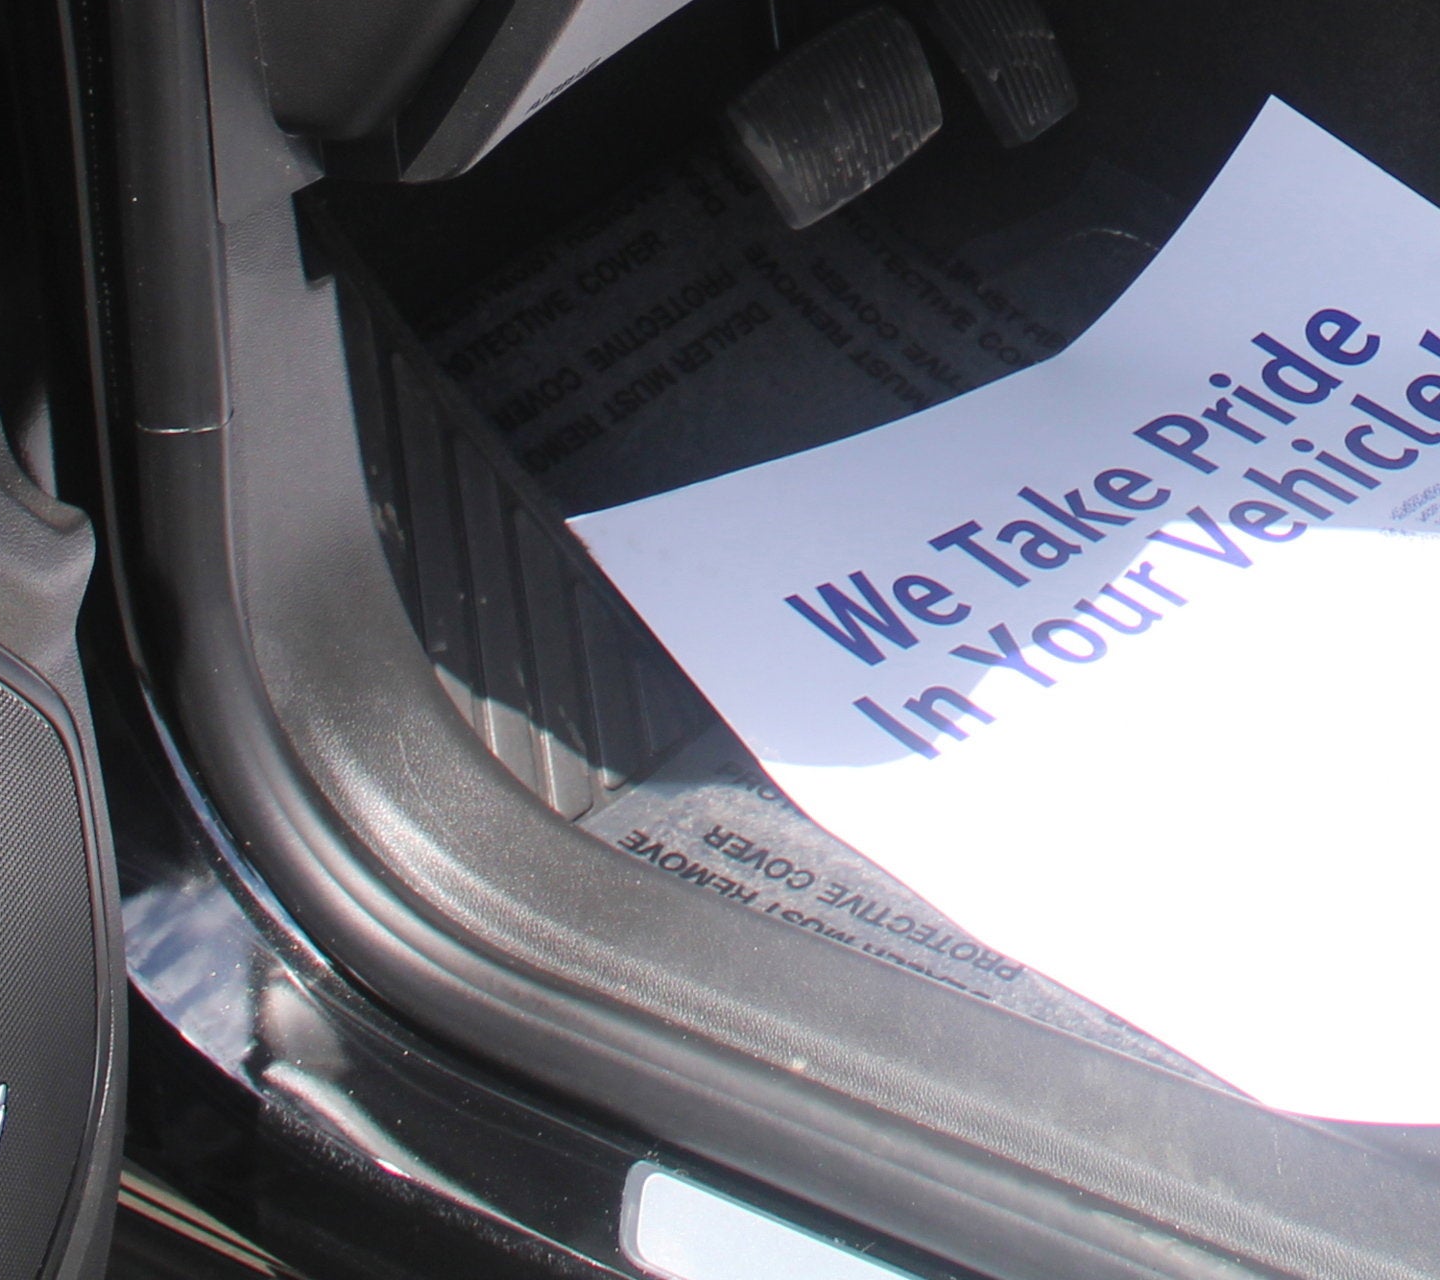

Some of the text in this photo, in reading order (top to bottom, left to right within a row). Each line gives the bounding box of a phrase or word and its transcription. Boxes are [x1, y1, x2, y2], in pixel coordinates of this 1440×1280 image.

[576, 229, 667, 296] COVER
[785, 305, 1380, 667] We Take Pride
[854, 679, 997, 761] In
[978, 556, 1192, 690] Your
[702, 823, 815, 891] COVER
[818, 880, 1026, 983] PROTECTIVE
